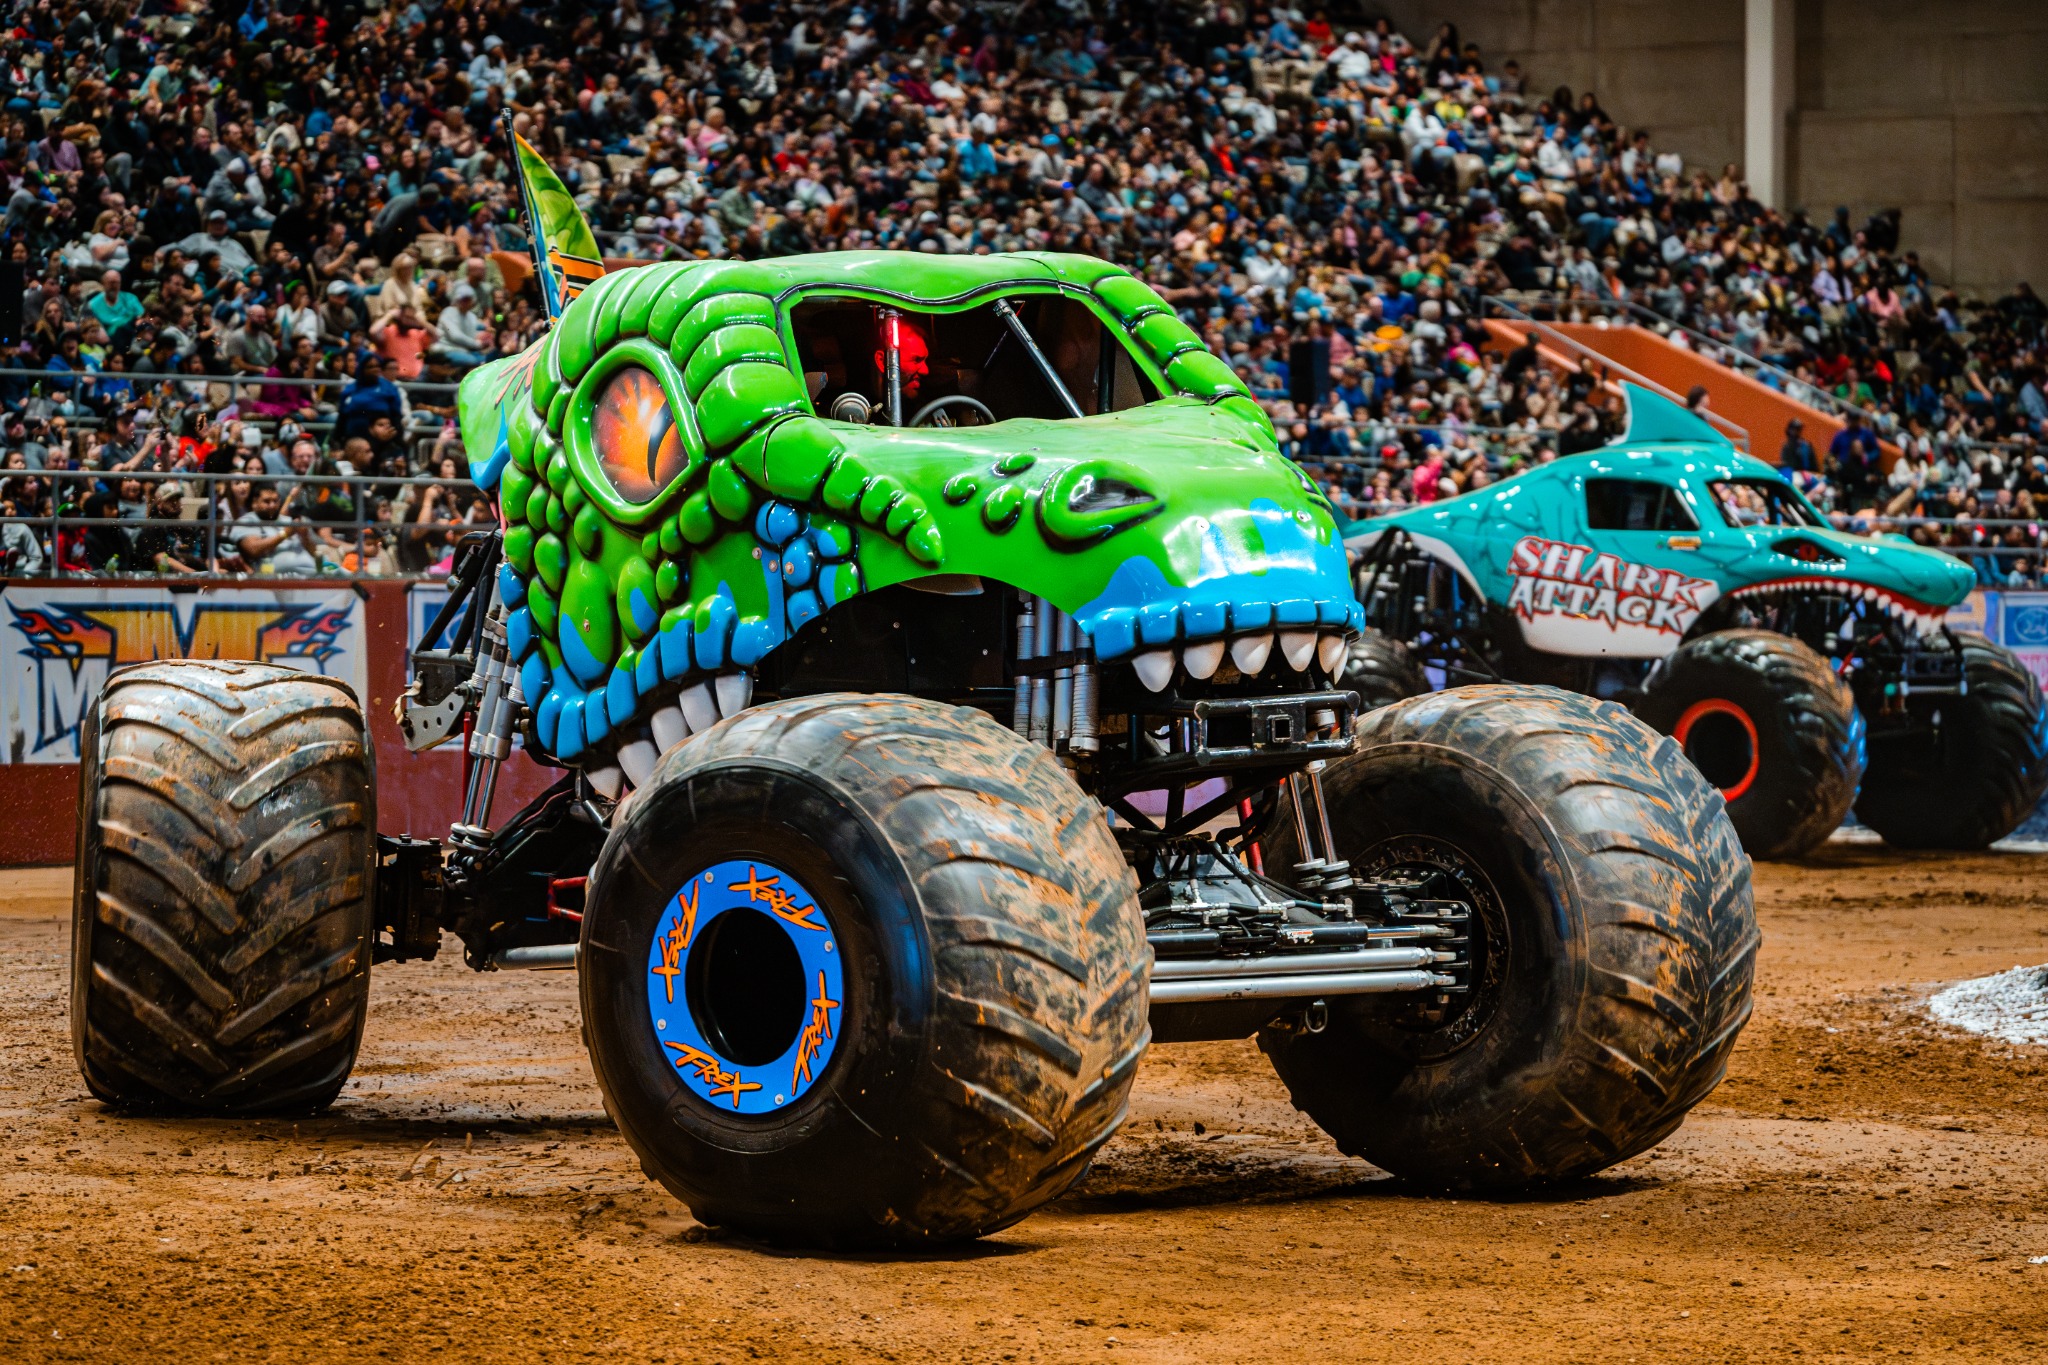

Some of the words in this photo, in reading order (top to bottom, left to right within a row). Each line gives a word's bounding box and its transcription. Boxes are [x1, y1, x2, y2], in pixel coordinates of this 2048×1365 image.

[1507, 536, 1712, 609] SHARK
[1508, 574, 1686, 635] ATTACK
[664, 1040, 763, 1108] T-REX
